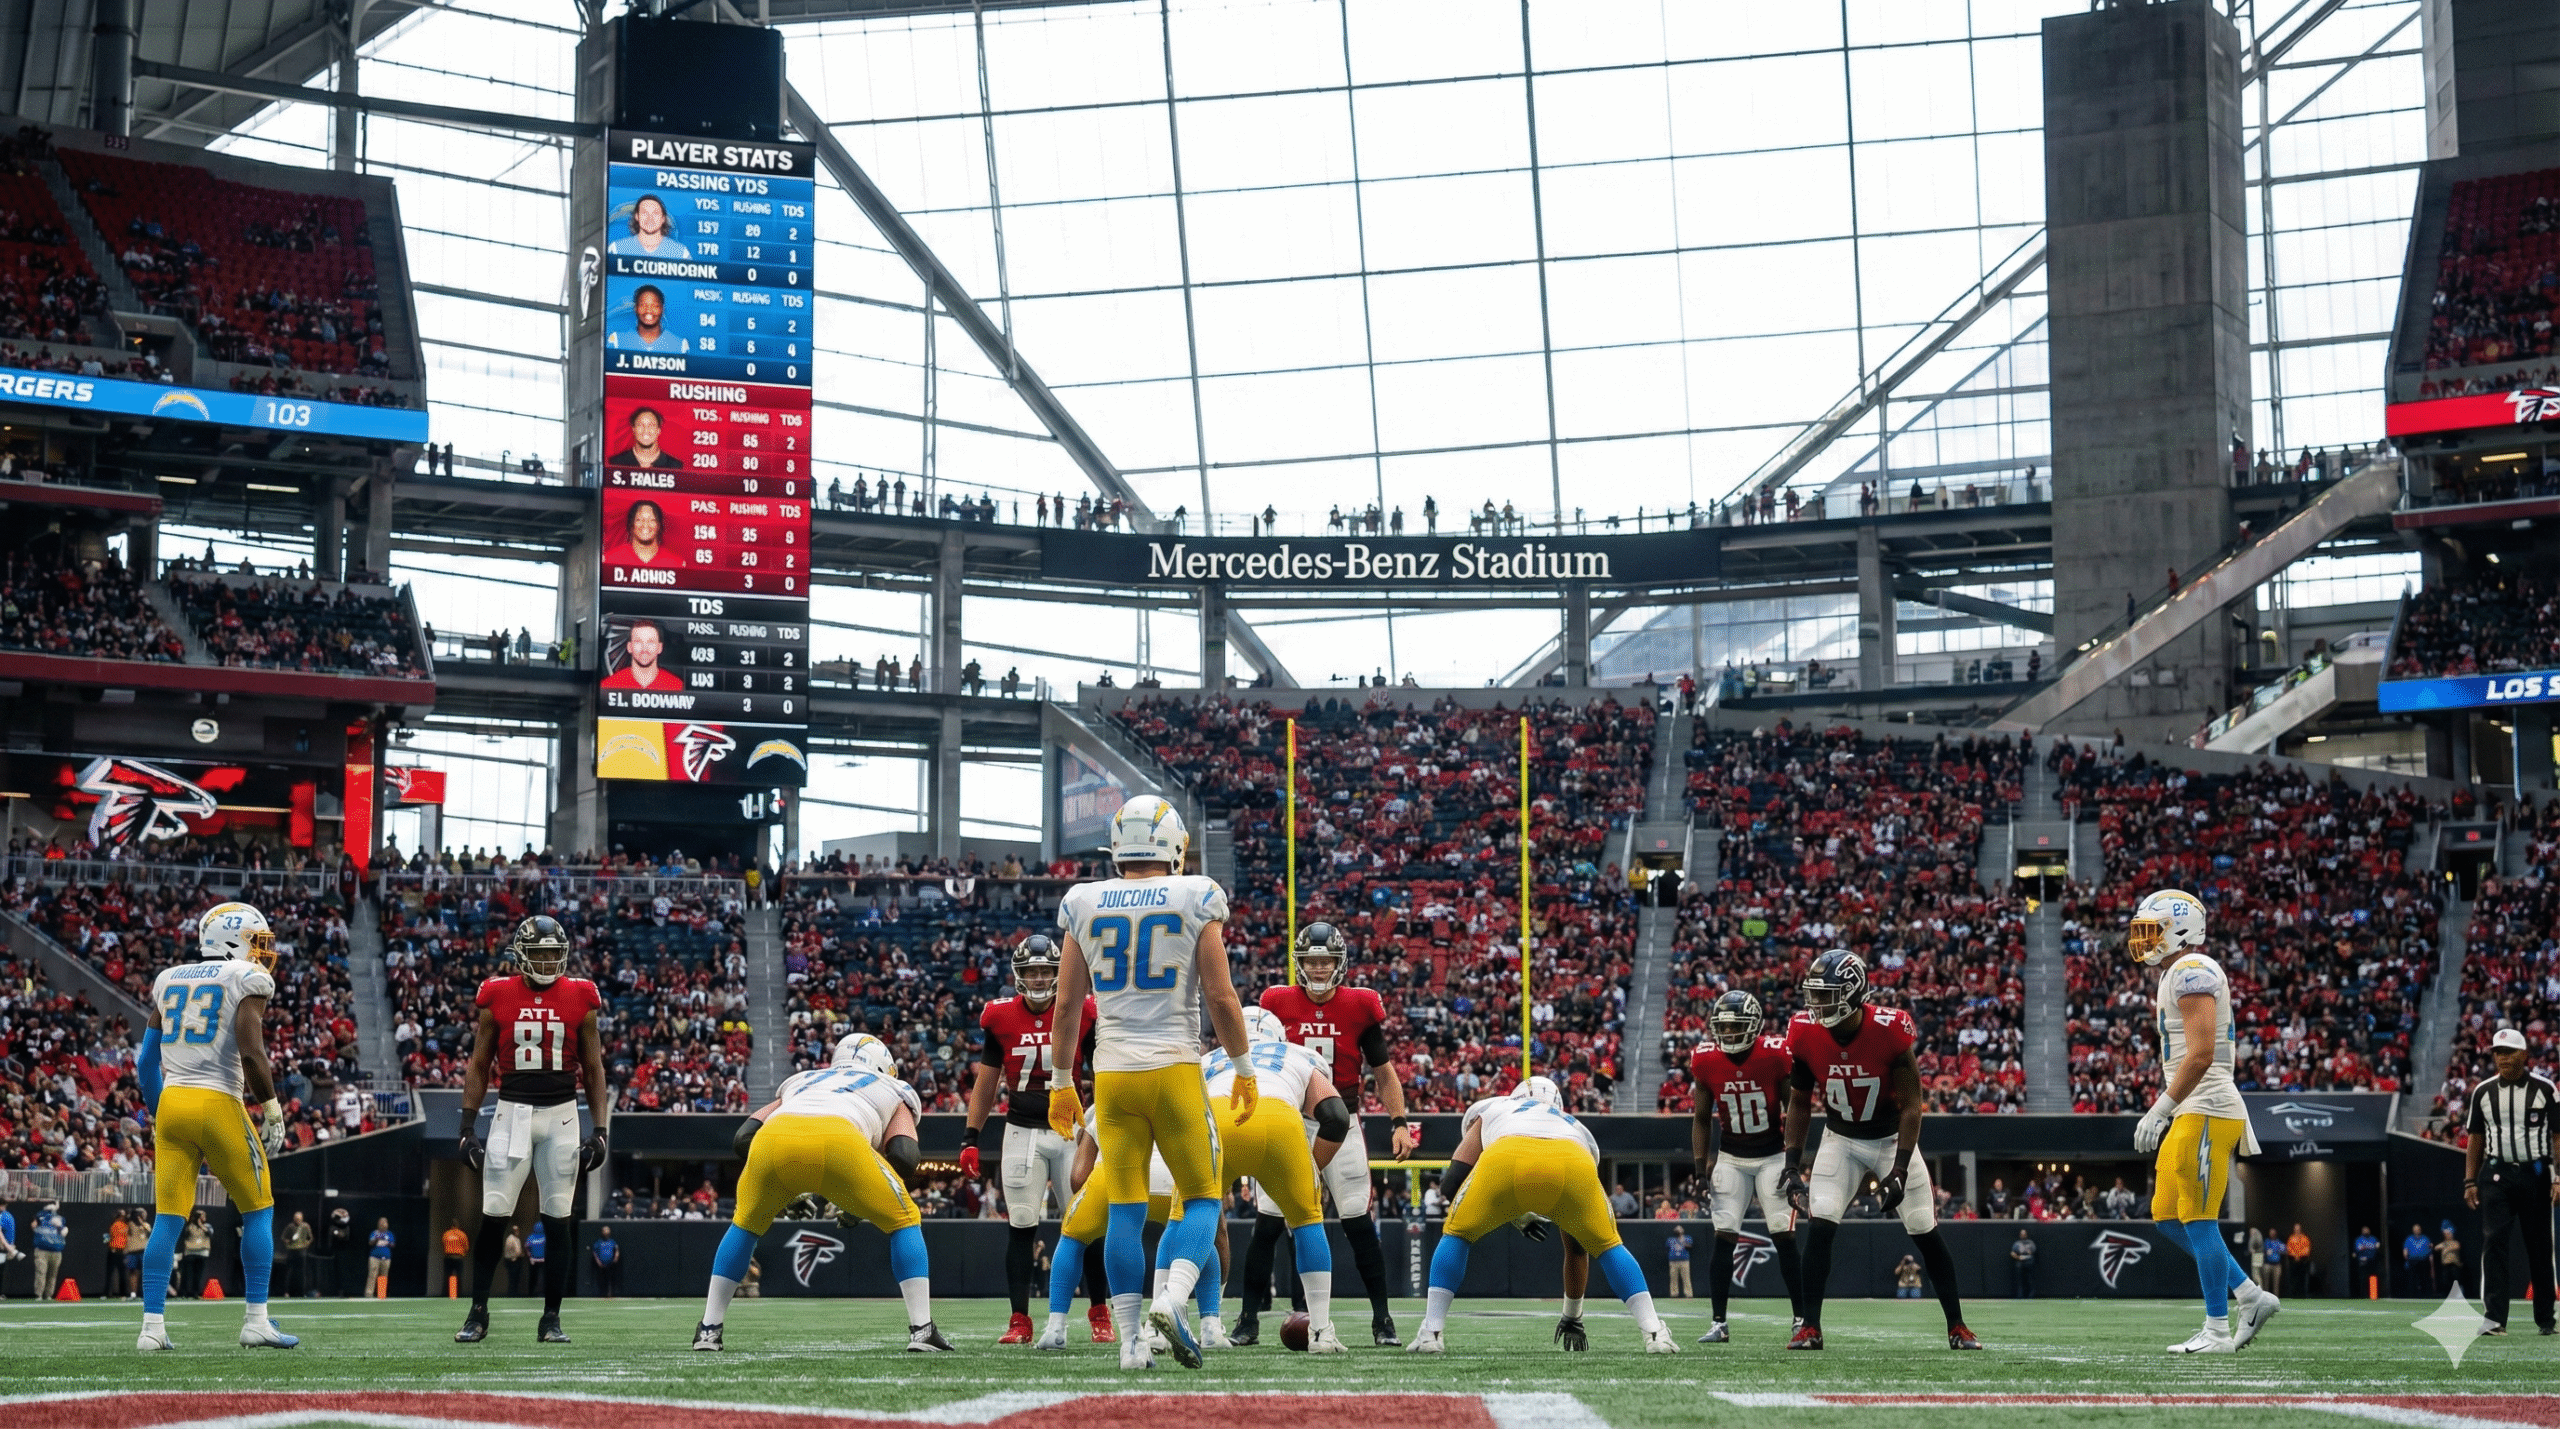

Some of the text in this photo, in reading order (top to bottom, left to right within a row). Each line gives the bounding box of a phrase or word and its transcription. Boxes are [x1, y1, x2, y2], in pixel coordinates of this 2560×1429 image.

[632, 138, 793, 170] PLAYER STATS
[656, 171, 768, 195] PASSING YDS
[782, 204, 804, 218] TDS
[789, 227, 798, 241] 2
[747, 246, 760, 259] 12
[748, 268, 797, 285] 0 0
[781, 294, 804, 308] TDS
[788, 320, 796, 333] 2
[616, 354, 629, 368] J.
[747, 362, 797, 379] 0 0
[670, 383, 747, 403] RUSHING
[267, 402, 311, 427] 103
[780, 414, 802, 427] TDS
[787, 436, 795, 450] 2
[612, 470, 626, 486] S.
[743, 479, 795, 496] 10 0
[691, 500, 720, 514] PAS.
[779, 504, 801, 518] TDS
[741, 552, 757, 566] 20
[786, 554, 794, 569] 2
[1148, 542, 1611, 581] Mercedes-Benz Stadium
[614, 567, 627, 582] D.
[744, 574, 795, 591] 3 0
[688, 598, 723, 615] TDS
[777, 627, 800, 640] TDS
[740, 650, 755, 665] 31
[784, 652, 793, 667] 2
[784, 676, 793, 691] 2
[2486, 677, 2543, 700] LOS
[783, 700, 793, 714] 0
[161, 984, 225, 1045] 33
[518, 1007, 560, 1021] ATL
[1298, 1022, 1341, 1035] ATL
[514, 1021, 565, 1070] 81
[1828, 1064, 1870, 1077] ATL
[1724, 1080, 1762, 1093] ATL
[1826, 1076, 1881, 1122] 47
[1720, 1091, 1769, 1134] 10
